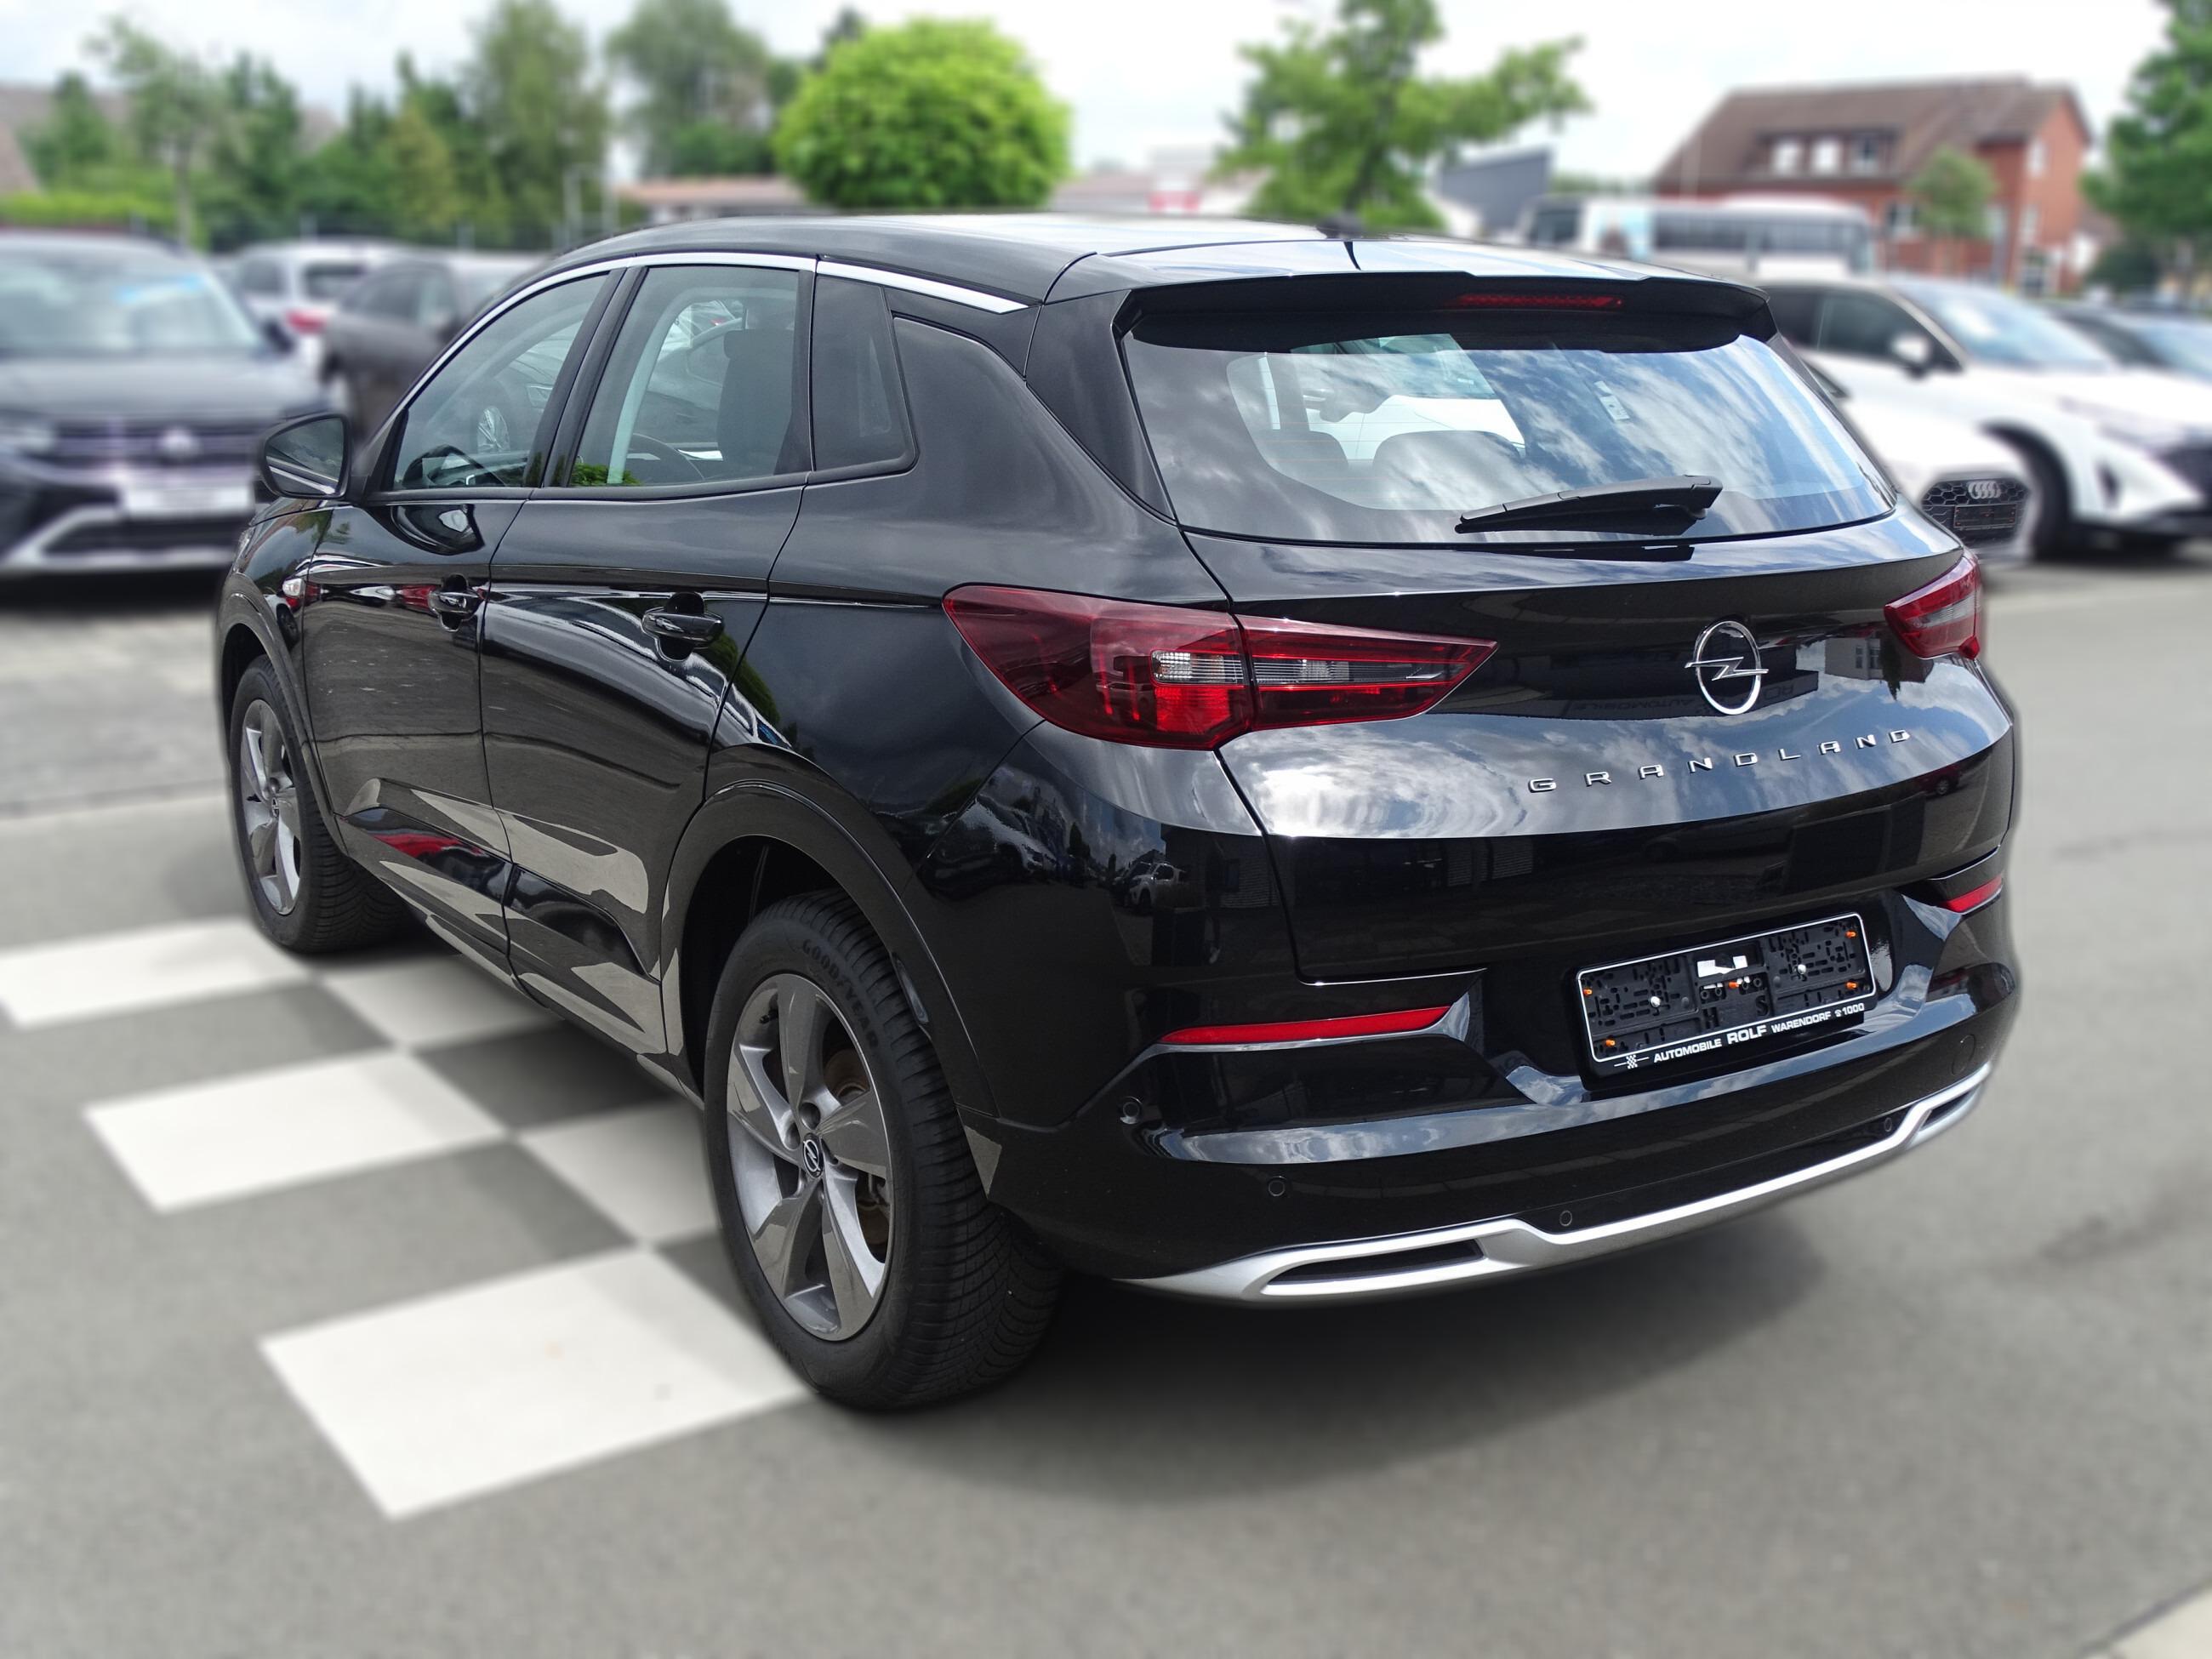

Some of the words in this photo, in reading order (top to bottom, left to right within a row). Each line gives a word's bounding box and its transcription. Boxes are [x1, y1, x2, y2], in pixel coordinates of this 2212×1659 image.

[1528, 729, 1911, 792] GRANDLAND
[803, 939, 878, 1046] GOODYEAR
[1654, 1038, 1722, 1063] AUTOMOBILE
[1726, 1024, 1767, 1045] ROLF
[1770, 1012, 1832, 1033] WARENDORF
[1842, 1002, 1864, 1016] 1000
